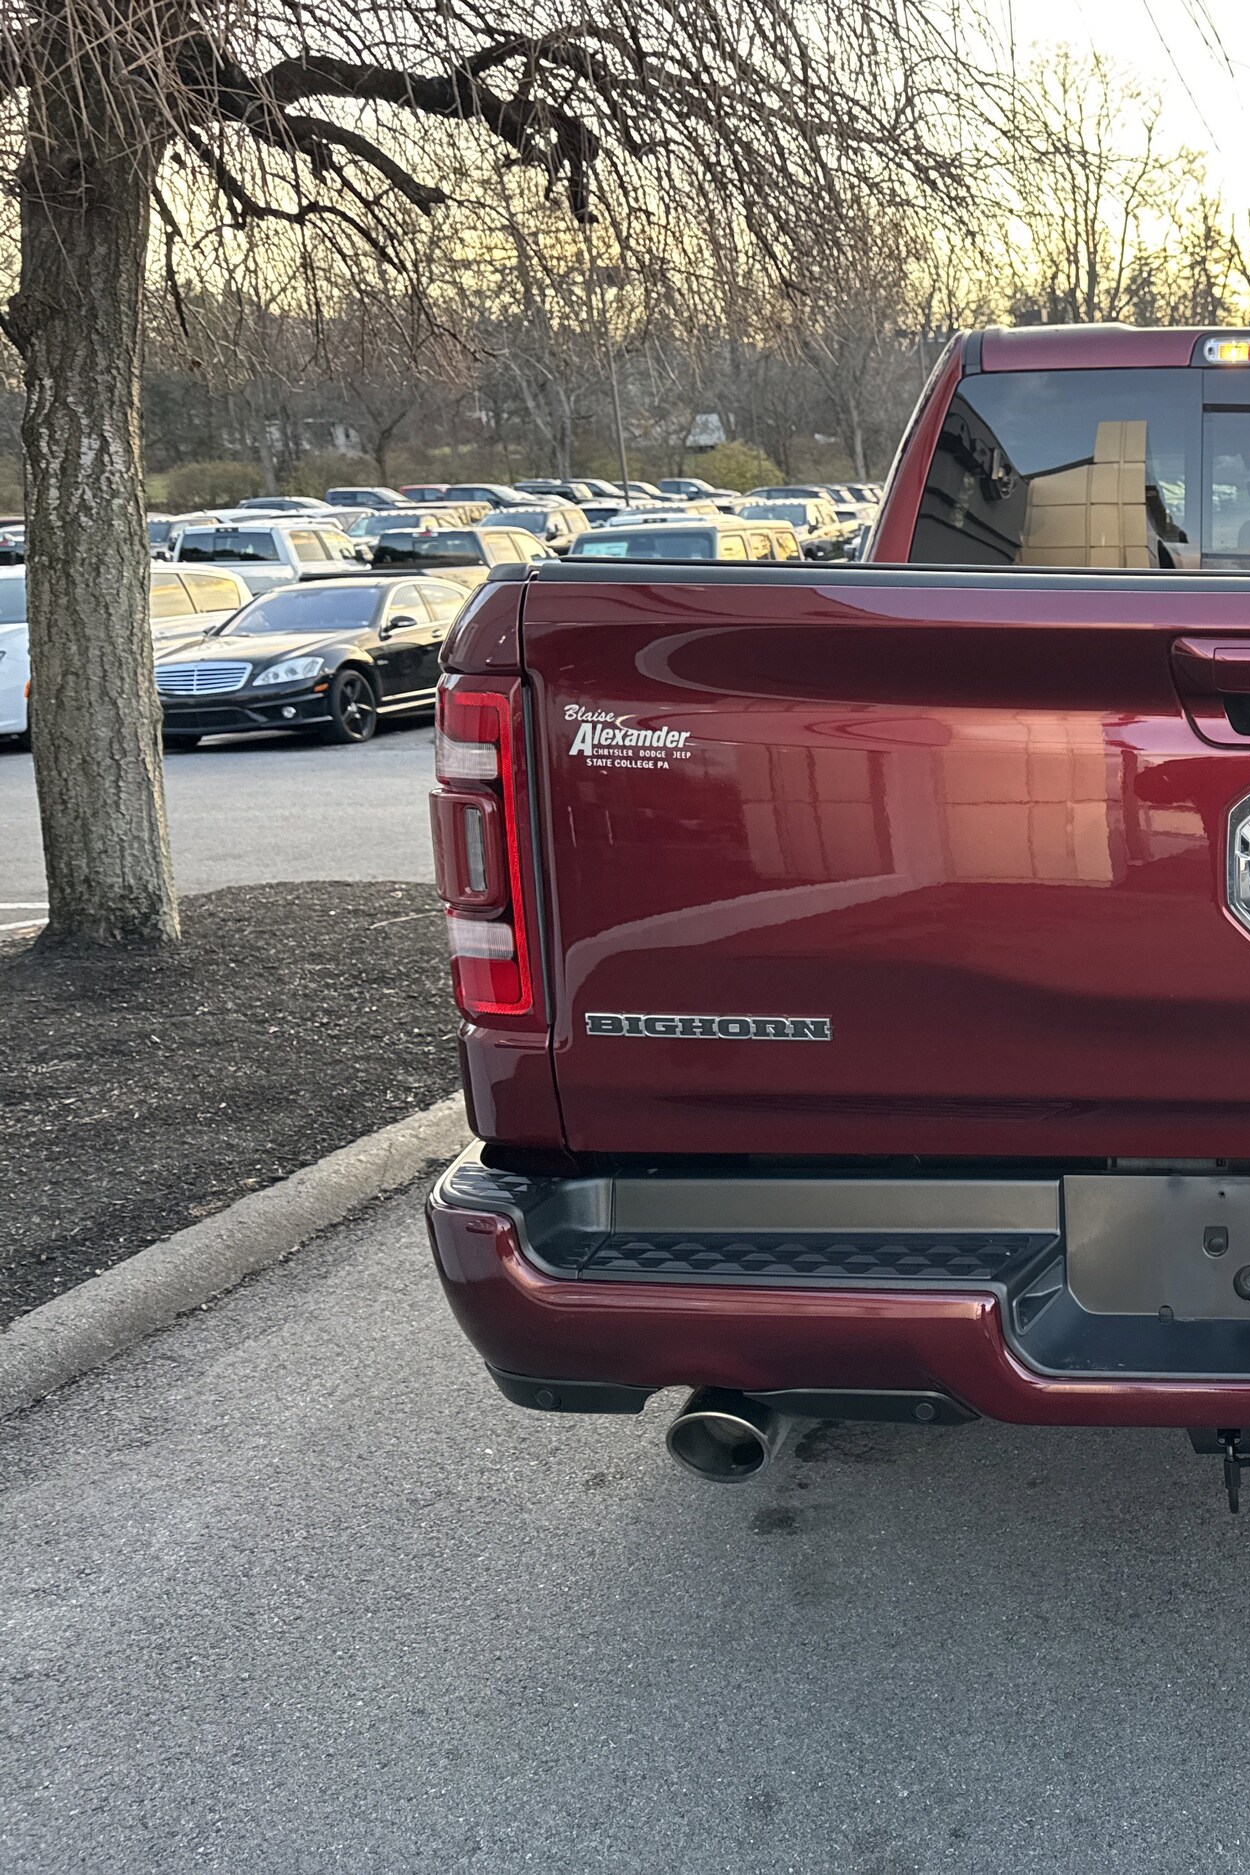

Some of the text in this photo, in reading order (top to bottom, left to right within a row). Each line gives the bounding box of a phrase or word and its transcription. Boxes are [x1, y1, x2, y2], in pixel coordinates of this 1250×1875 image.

[564, 704, 615, 721] Blaise
[568, 722, 691, 756] Alexander
[593, 748, 692, 759] CHRYSLER DODGE JEEP
[586, 758, 670, 769] STATE COLLEGE PA
[585, 1013, 832, 1041] BIGHORN
